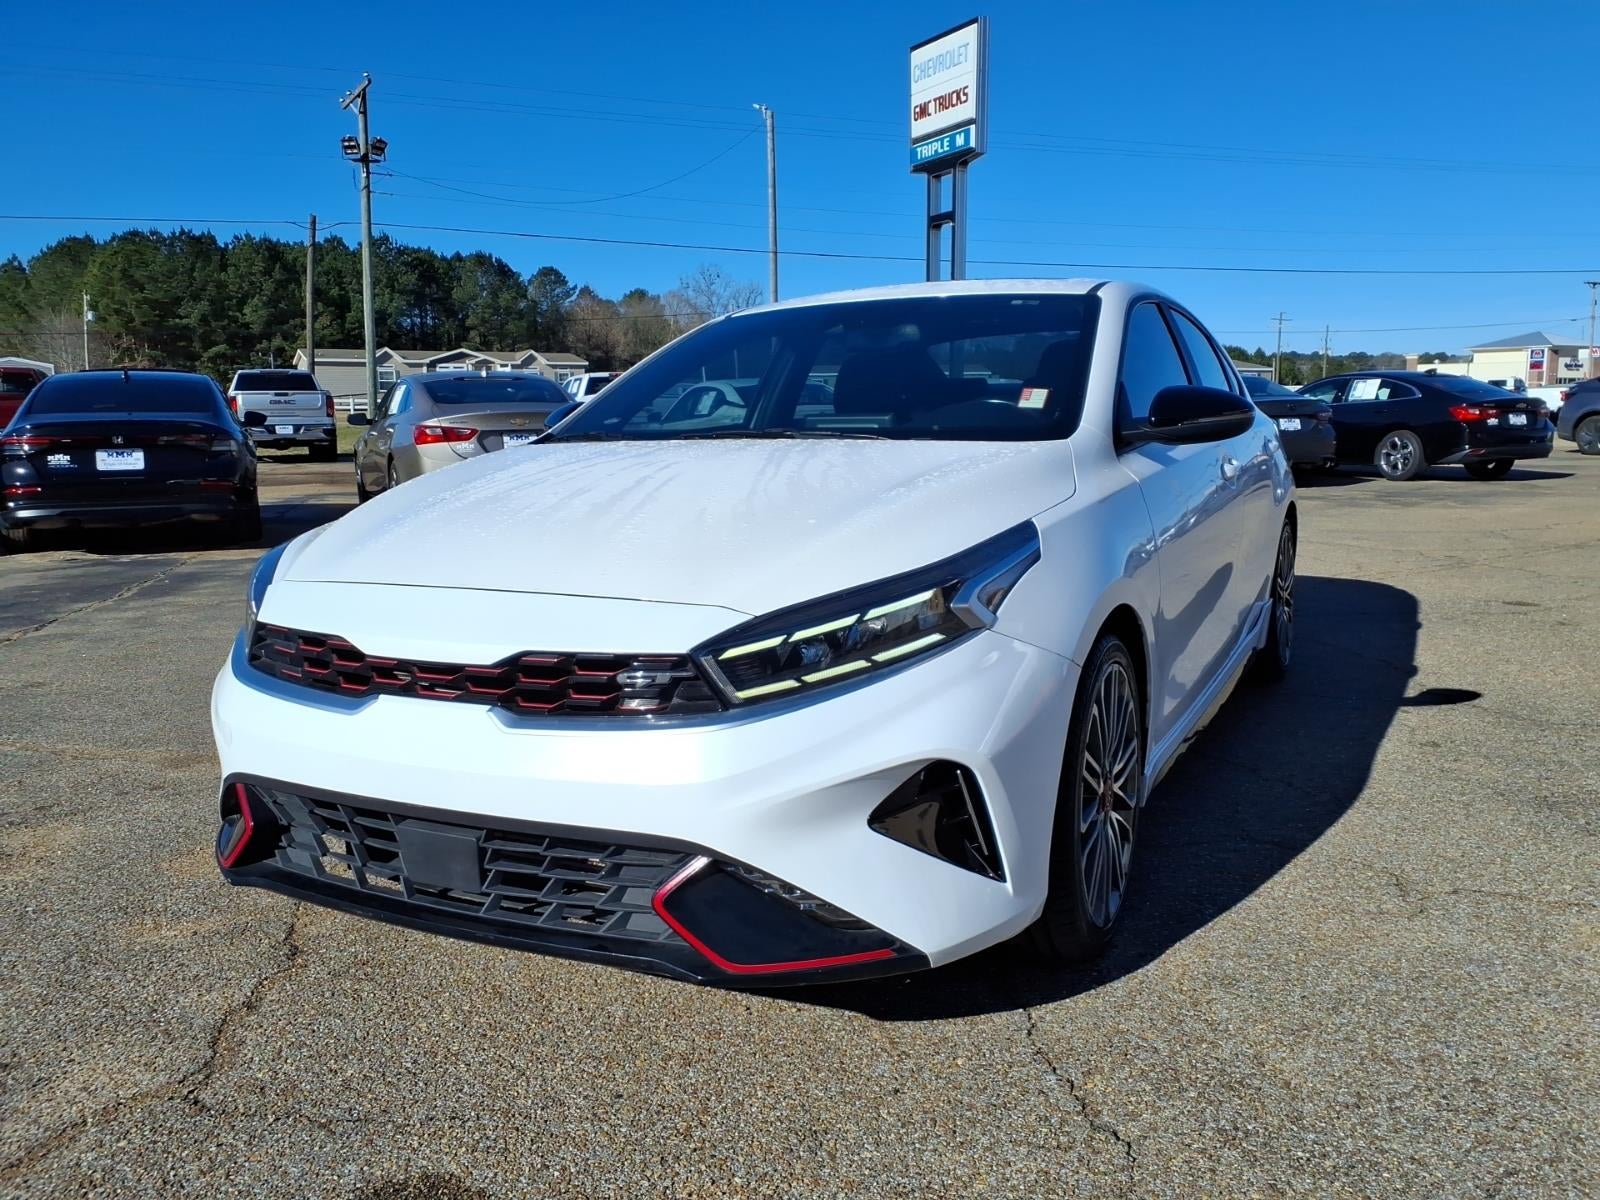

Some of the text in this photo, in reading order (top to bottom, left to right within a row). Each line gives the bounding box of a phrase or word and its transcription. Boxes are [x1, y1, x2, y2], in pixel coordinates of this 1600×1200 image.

[912, 42, 970, 84] CHEVROLET
[913, 85, 969, 122] GMC TRUCKS
[917, 132, 965, 160] TRIPLE M
